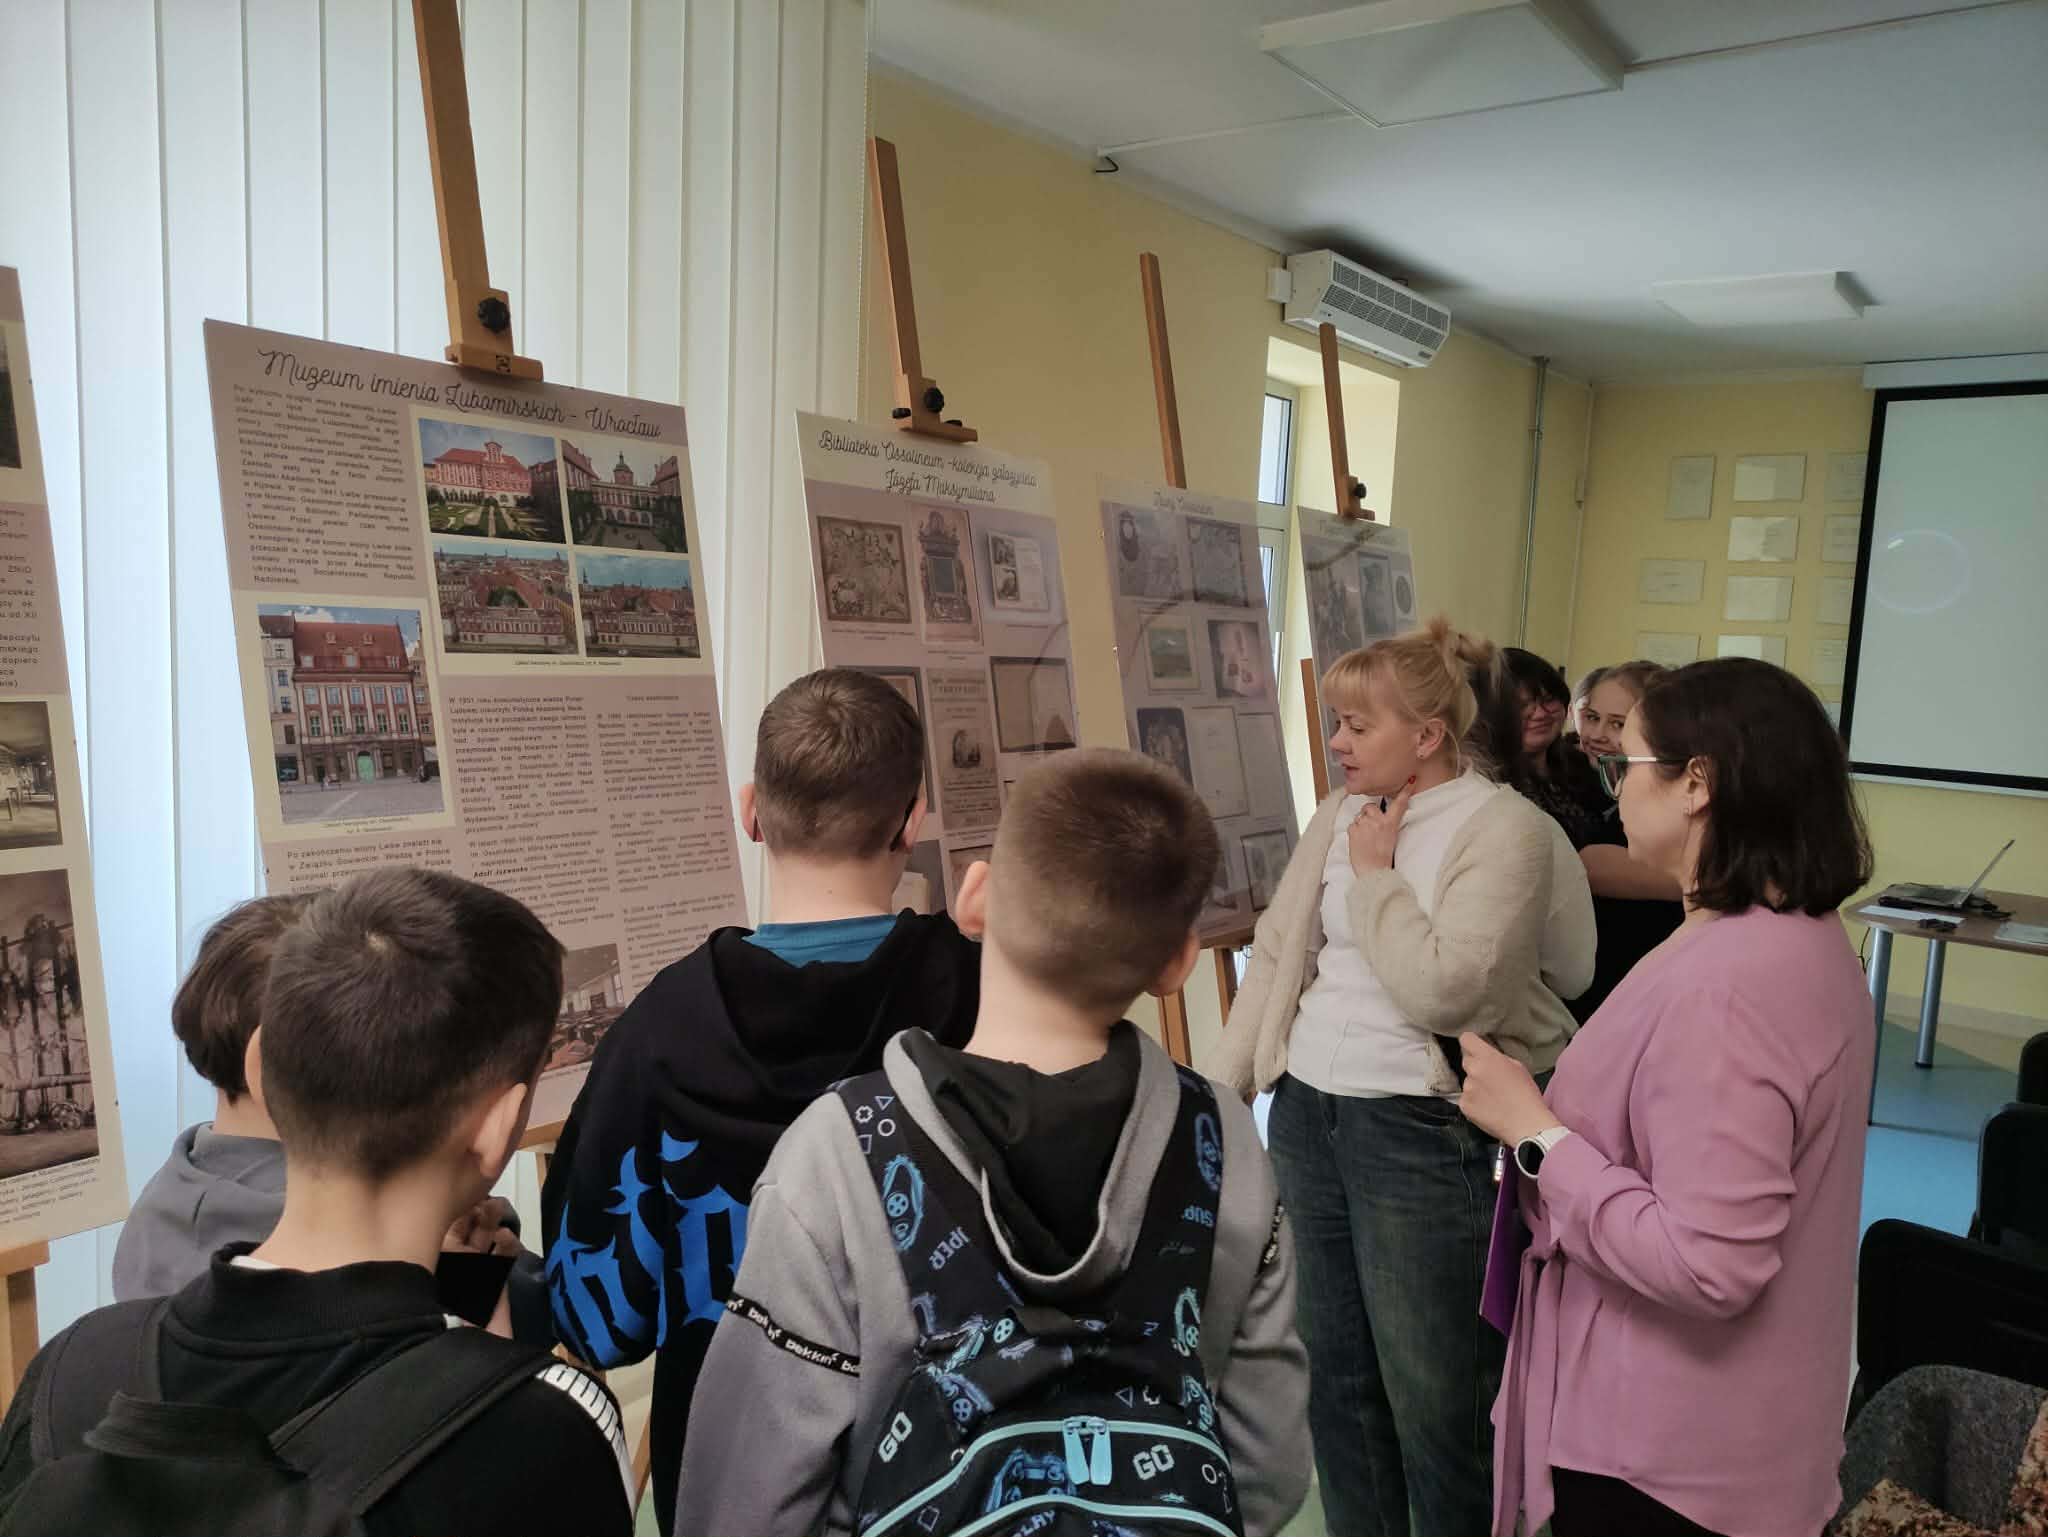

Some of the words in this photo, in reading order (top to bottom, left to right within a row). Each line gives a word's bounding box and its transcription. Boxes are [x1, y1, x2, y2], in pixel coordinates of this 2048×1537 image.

[257, 349, 364, 391] Muzeum
[371, 373, 440, 402] imienia
[446, 383, 566, 424] Lubomirskich
[585, 406, 662, 438] Wrocław
[818, 429, 880, 458] Biblioteka
[878, 1410, 913, 1464] GO
[1132, 1443, 1175, 1481] GO
